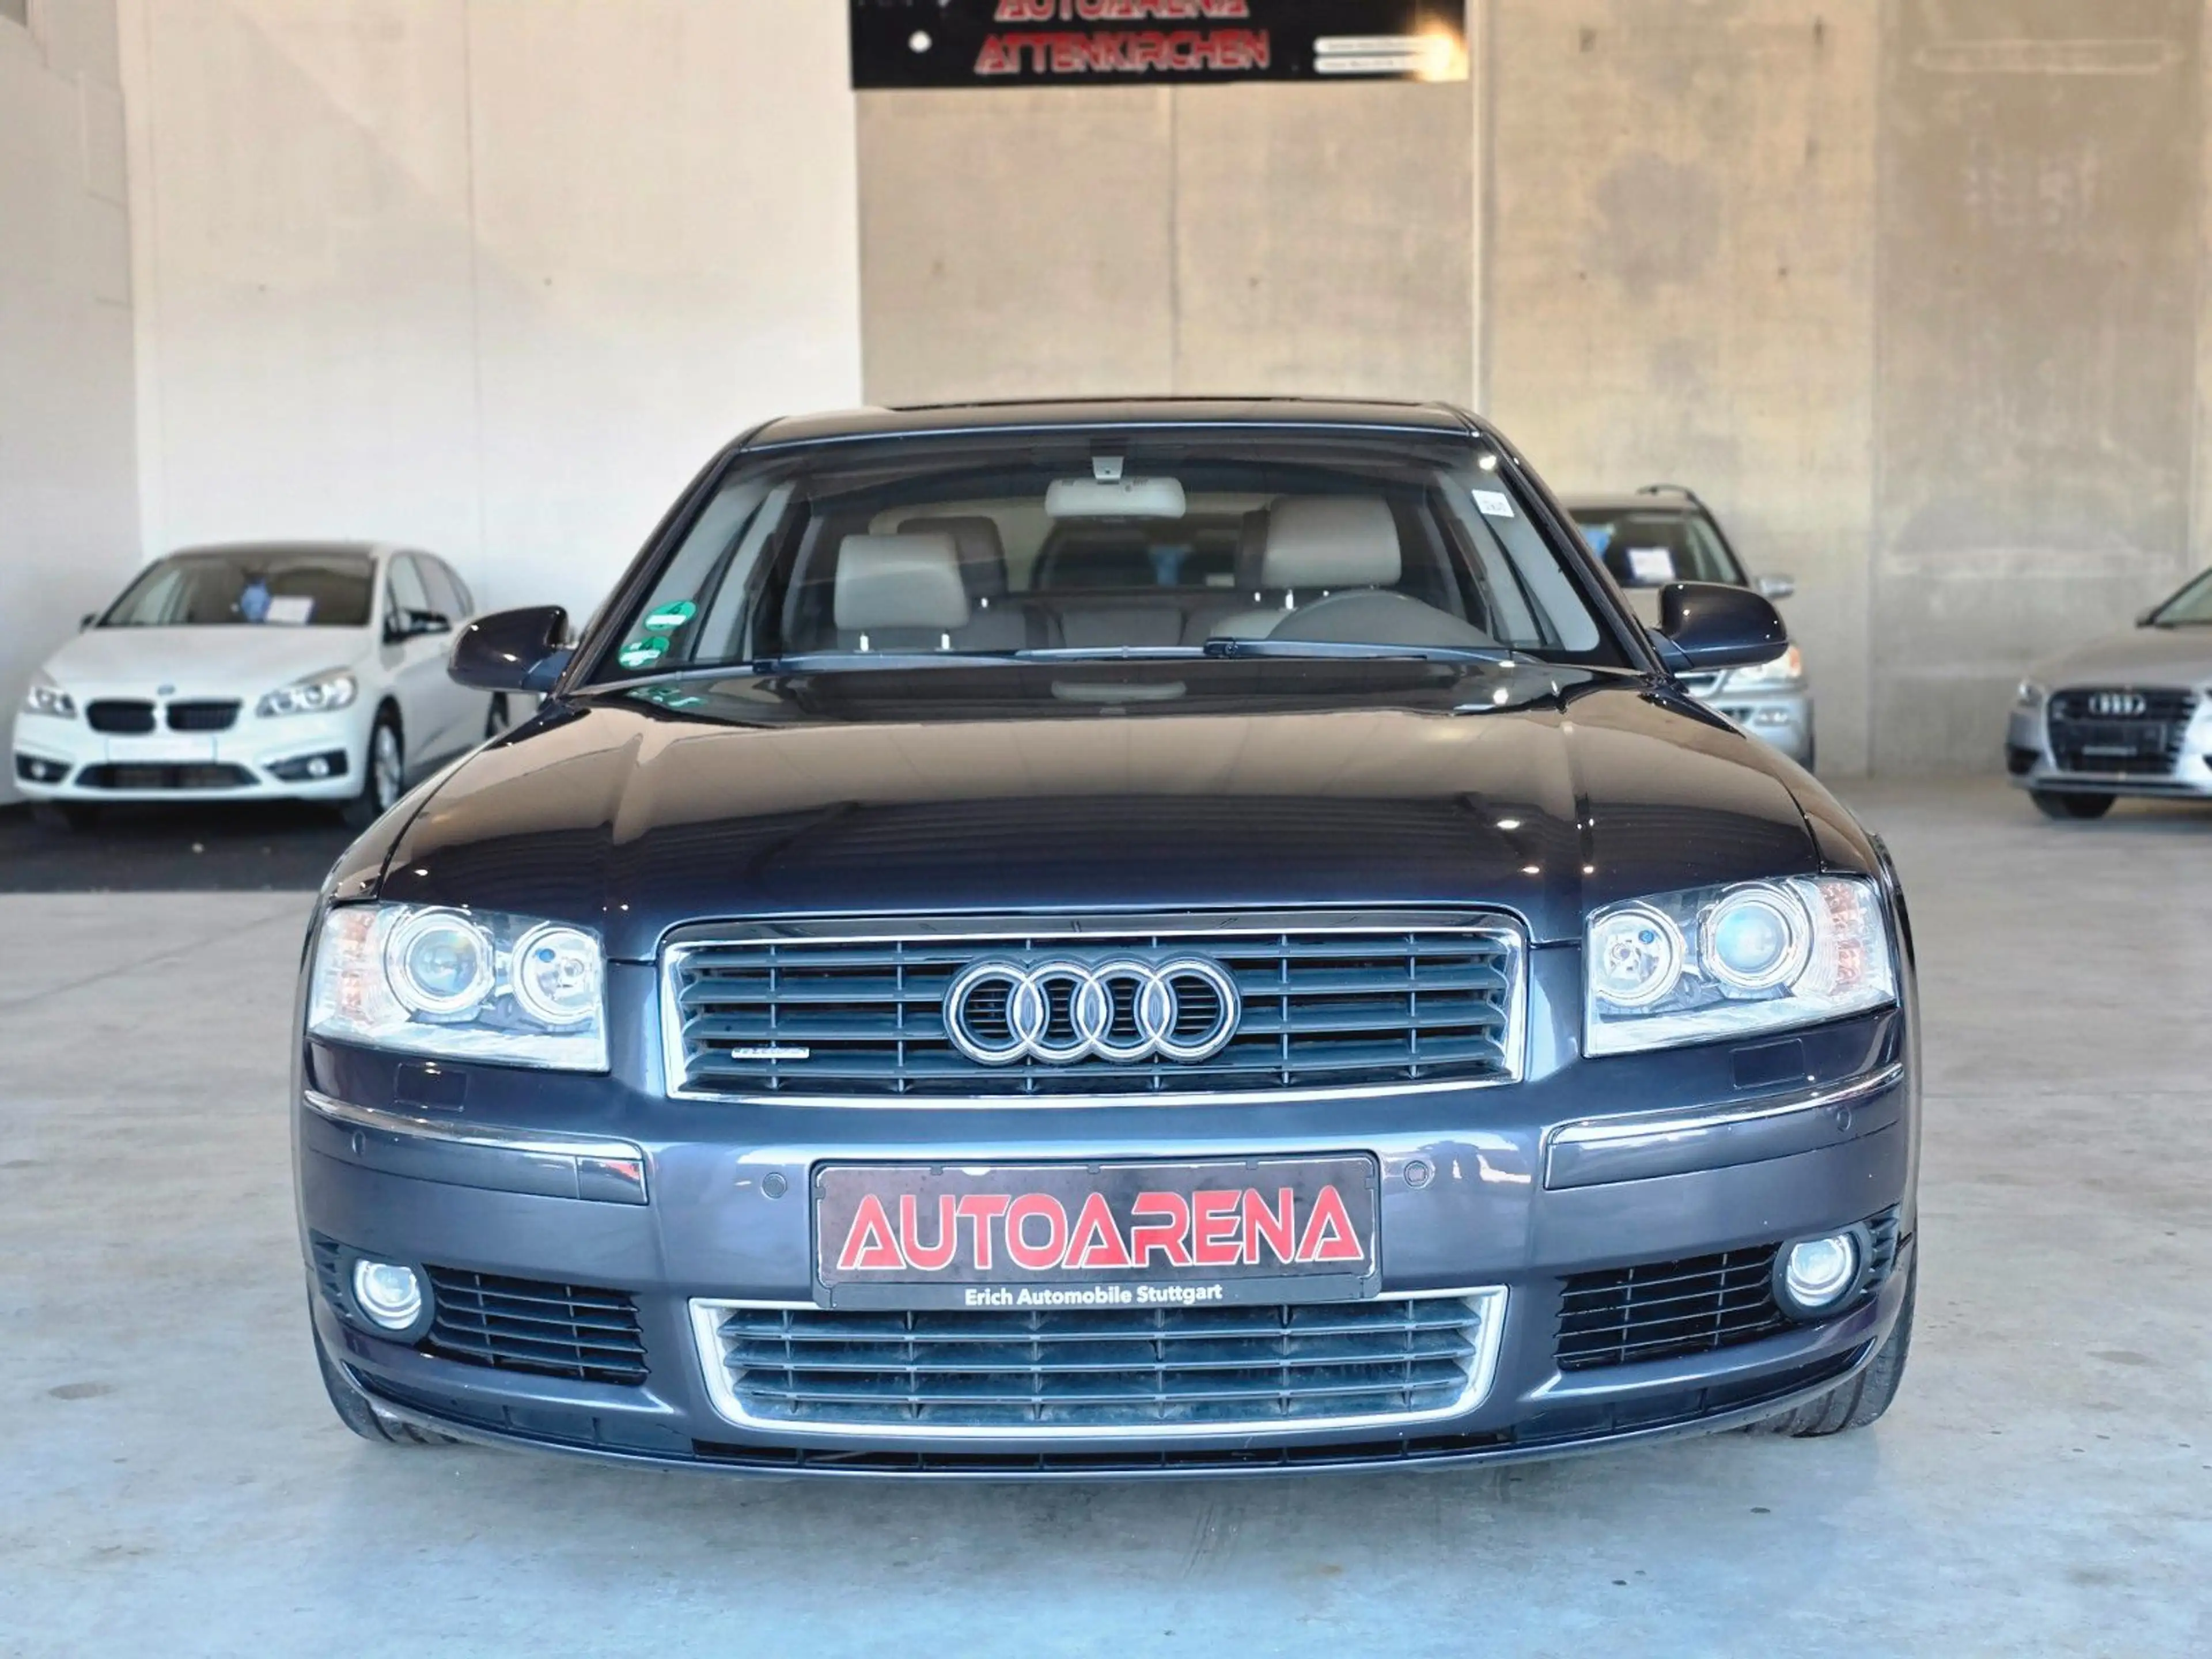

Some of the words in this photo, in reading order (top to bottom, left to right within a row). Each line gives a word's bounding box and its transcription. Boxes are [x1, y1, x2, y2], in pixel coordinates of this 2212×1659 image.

[974, 29, 1270, 74] ATTENKIRCHEN
[836, 1184, 1364, 1270] AUTOARENA
[964, 1288, 1013, 1305] Erich
[1016, 1285, 1132, 1305] Automobile
[1136, 1284, 1223, 1304] Stuttgart
